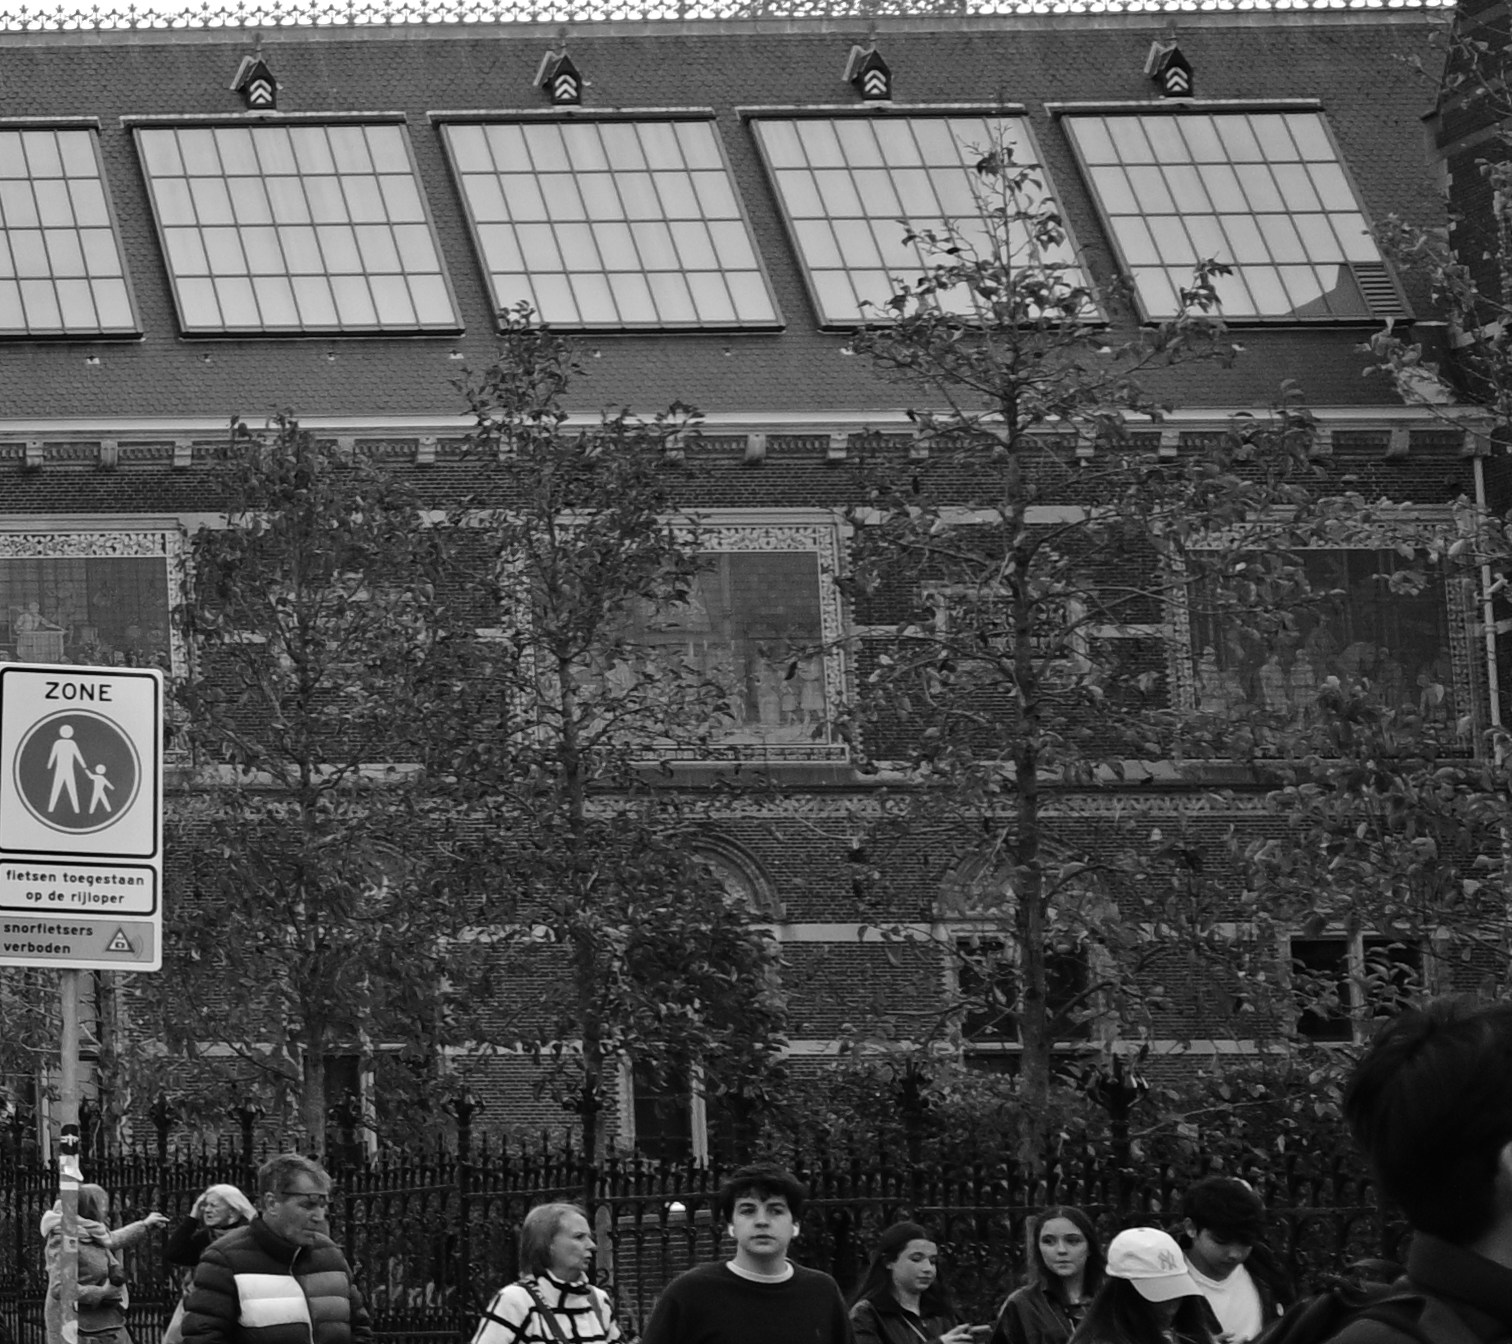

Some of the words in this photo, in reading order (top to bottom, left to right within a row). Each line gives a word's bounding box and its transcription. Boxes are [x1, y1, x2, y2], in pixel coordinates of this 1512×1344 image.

[44, 681, 113, 702] ZONE
[6, 869, 57, 882] fietsen
[62, 872, 144, 887] toegestaan
[25, 891, 43, 903] op
[48, 890, 65, 902] de
[70, 891, 125, 906] rijloper
[3, 923, 93, 936] snorfietsers
[3, 941, 71, 954] verboden
